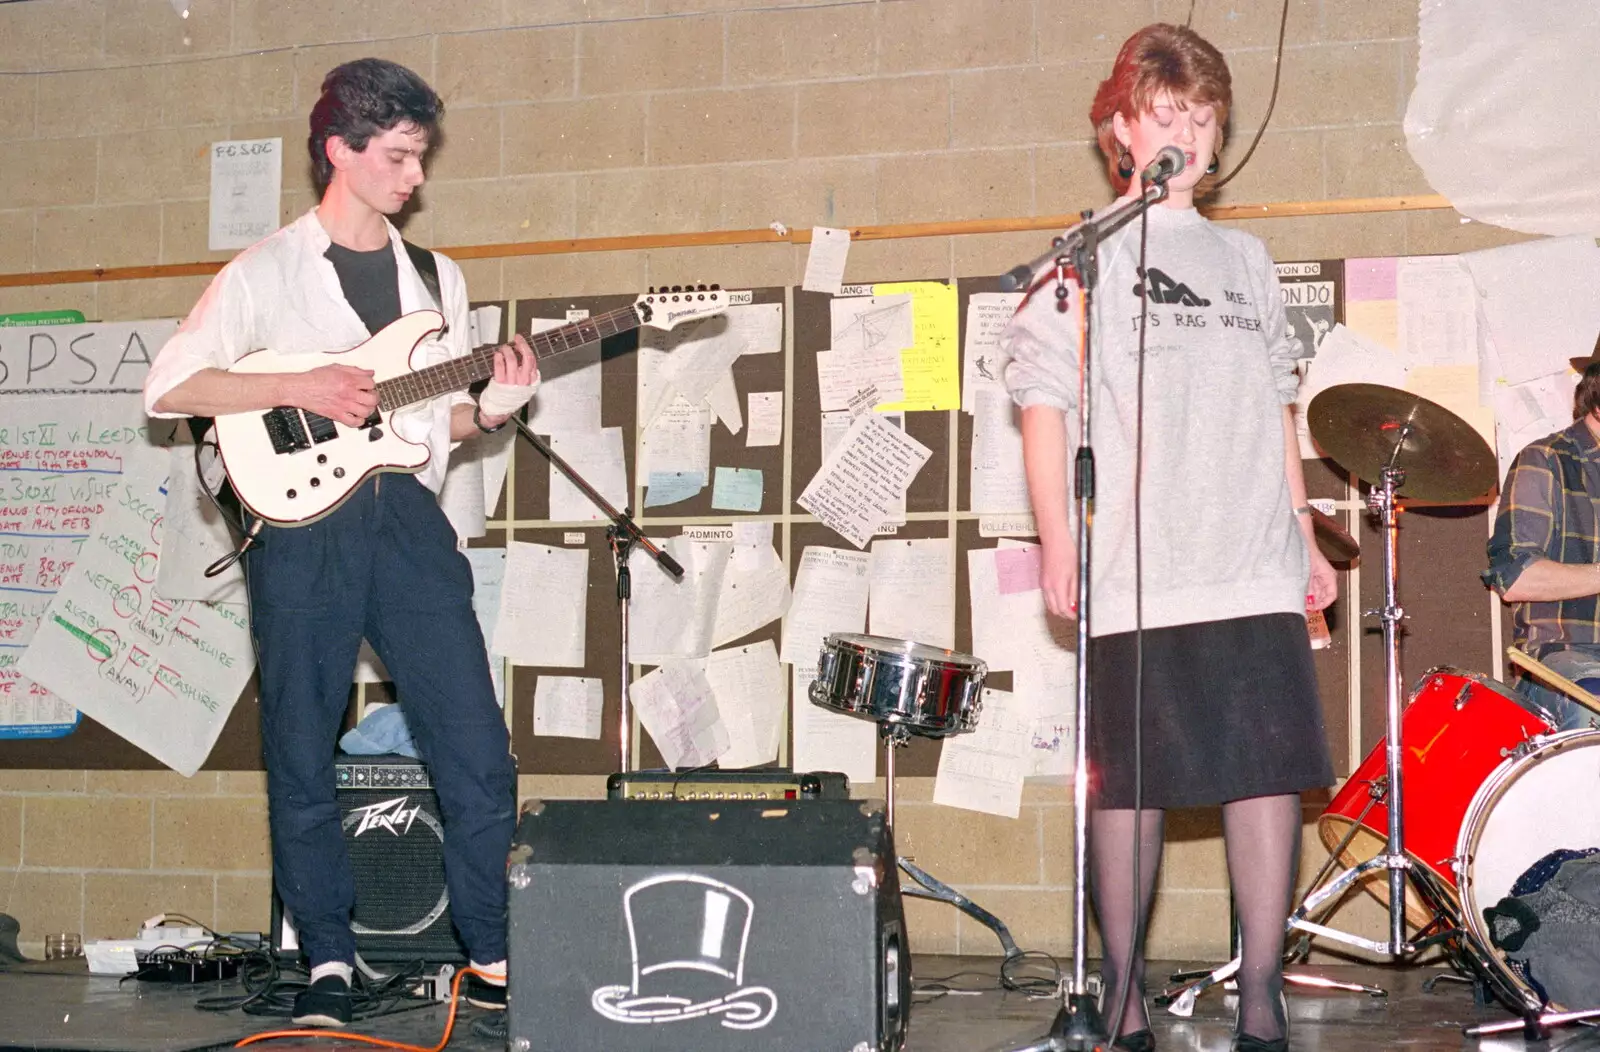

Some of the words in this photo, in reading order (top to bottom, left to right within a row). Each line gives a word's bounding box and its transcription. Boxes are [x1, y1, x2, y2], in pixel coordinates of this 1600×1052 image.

[1304, 264, 1319, 274] DO
[1173, 313, 1206, 328] RAG
[1219, 315, 1264, 332] WEEK
